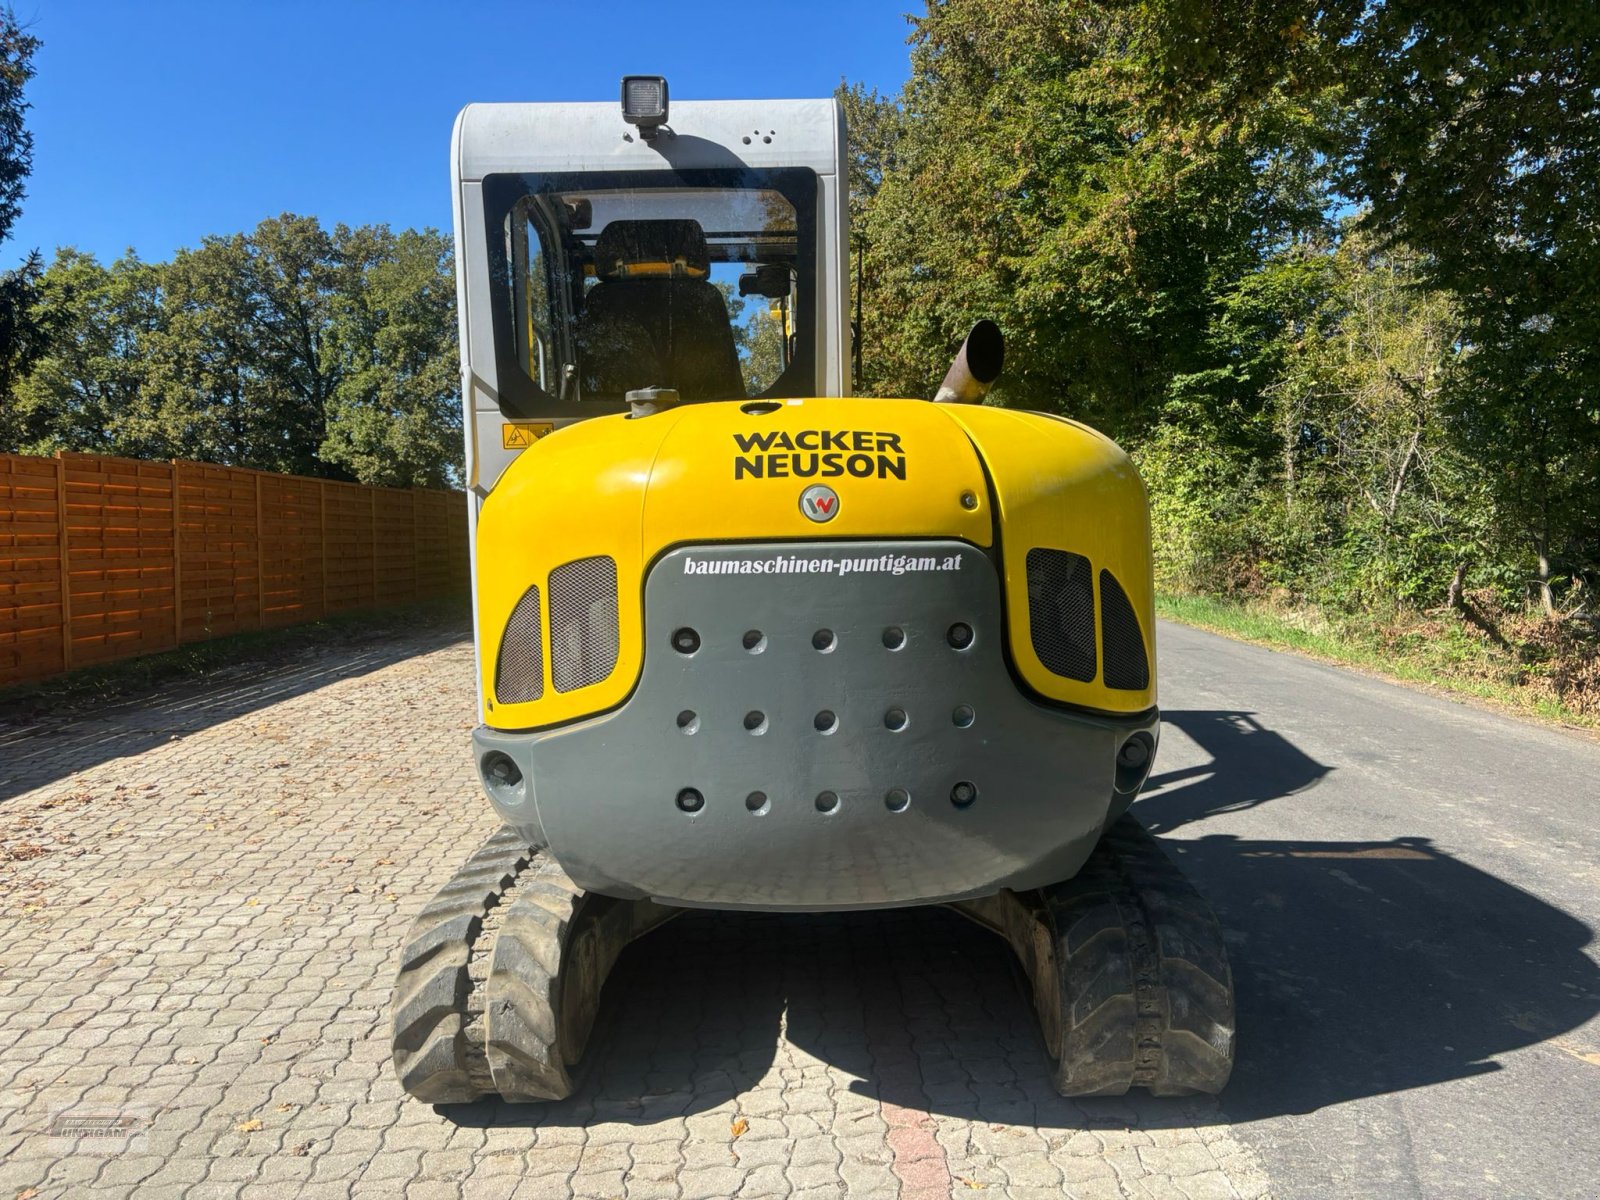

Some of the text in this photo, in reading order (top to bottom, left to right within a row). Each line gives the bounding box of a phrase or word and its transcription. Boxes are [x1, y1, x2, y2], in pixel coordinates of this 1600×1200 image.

[733, 430, 905, 453] WACKER
[734, 453, 907, 480] NEUSON
[684, 554, 962, 576] baumaschinen-puntigam.at
